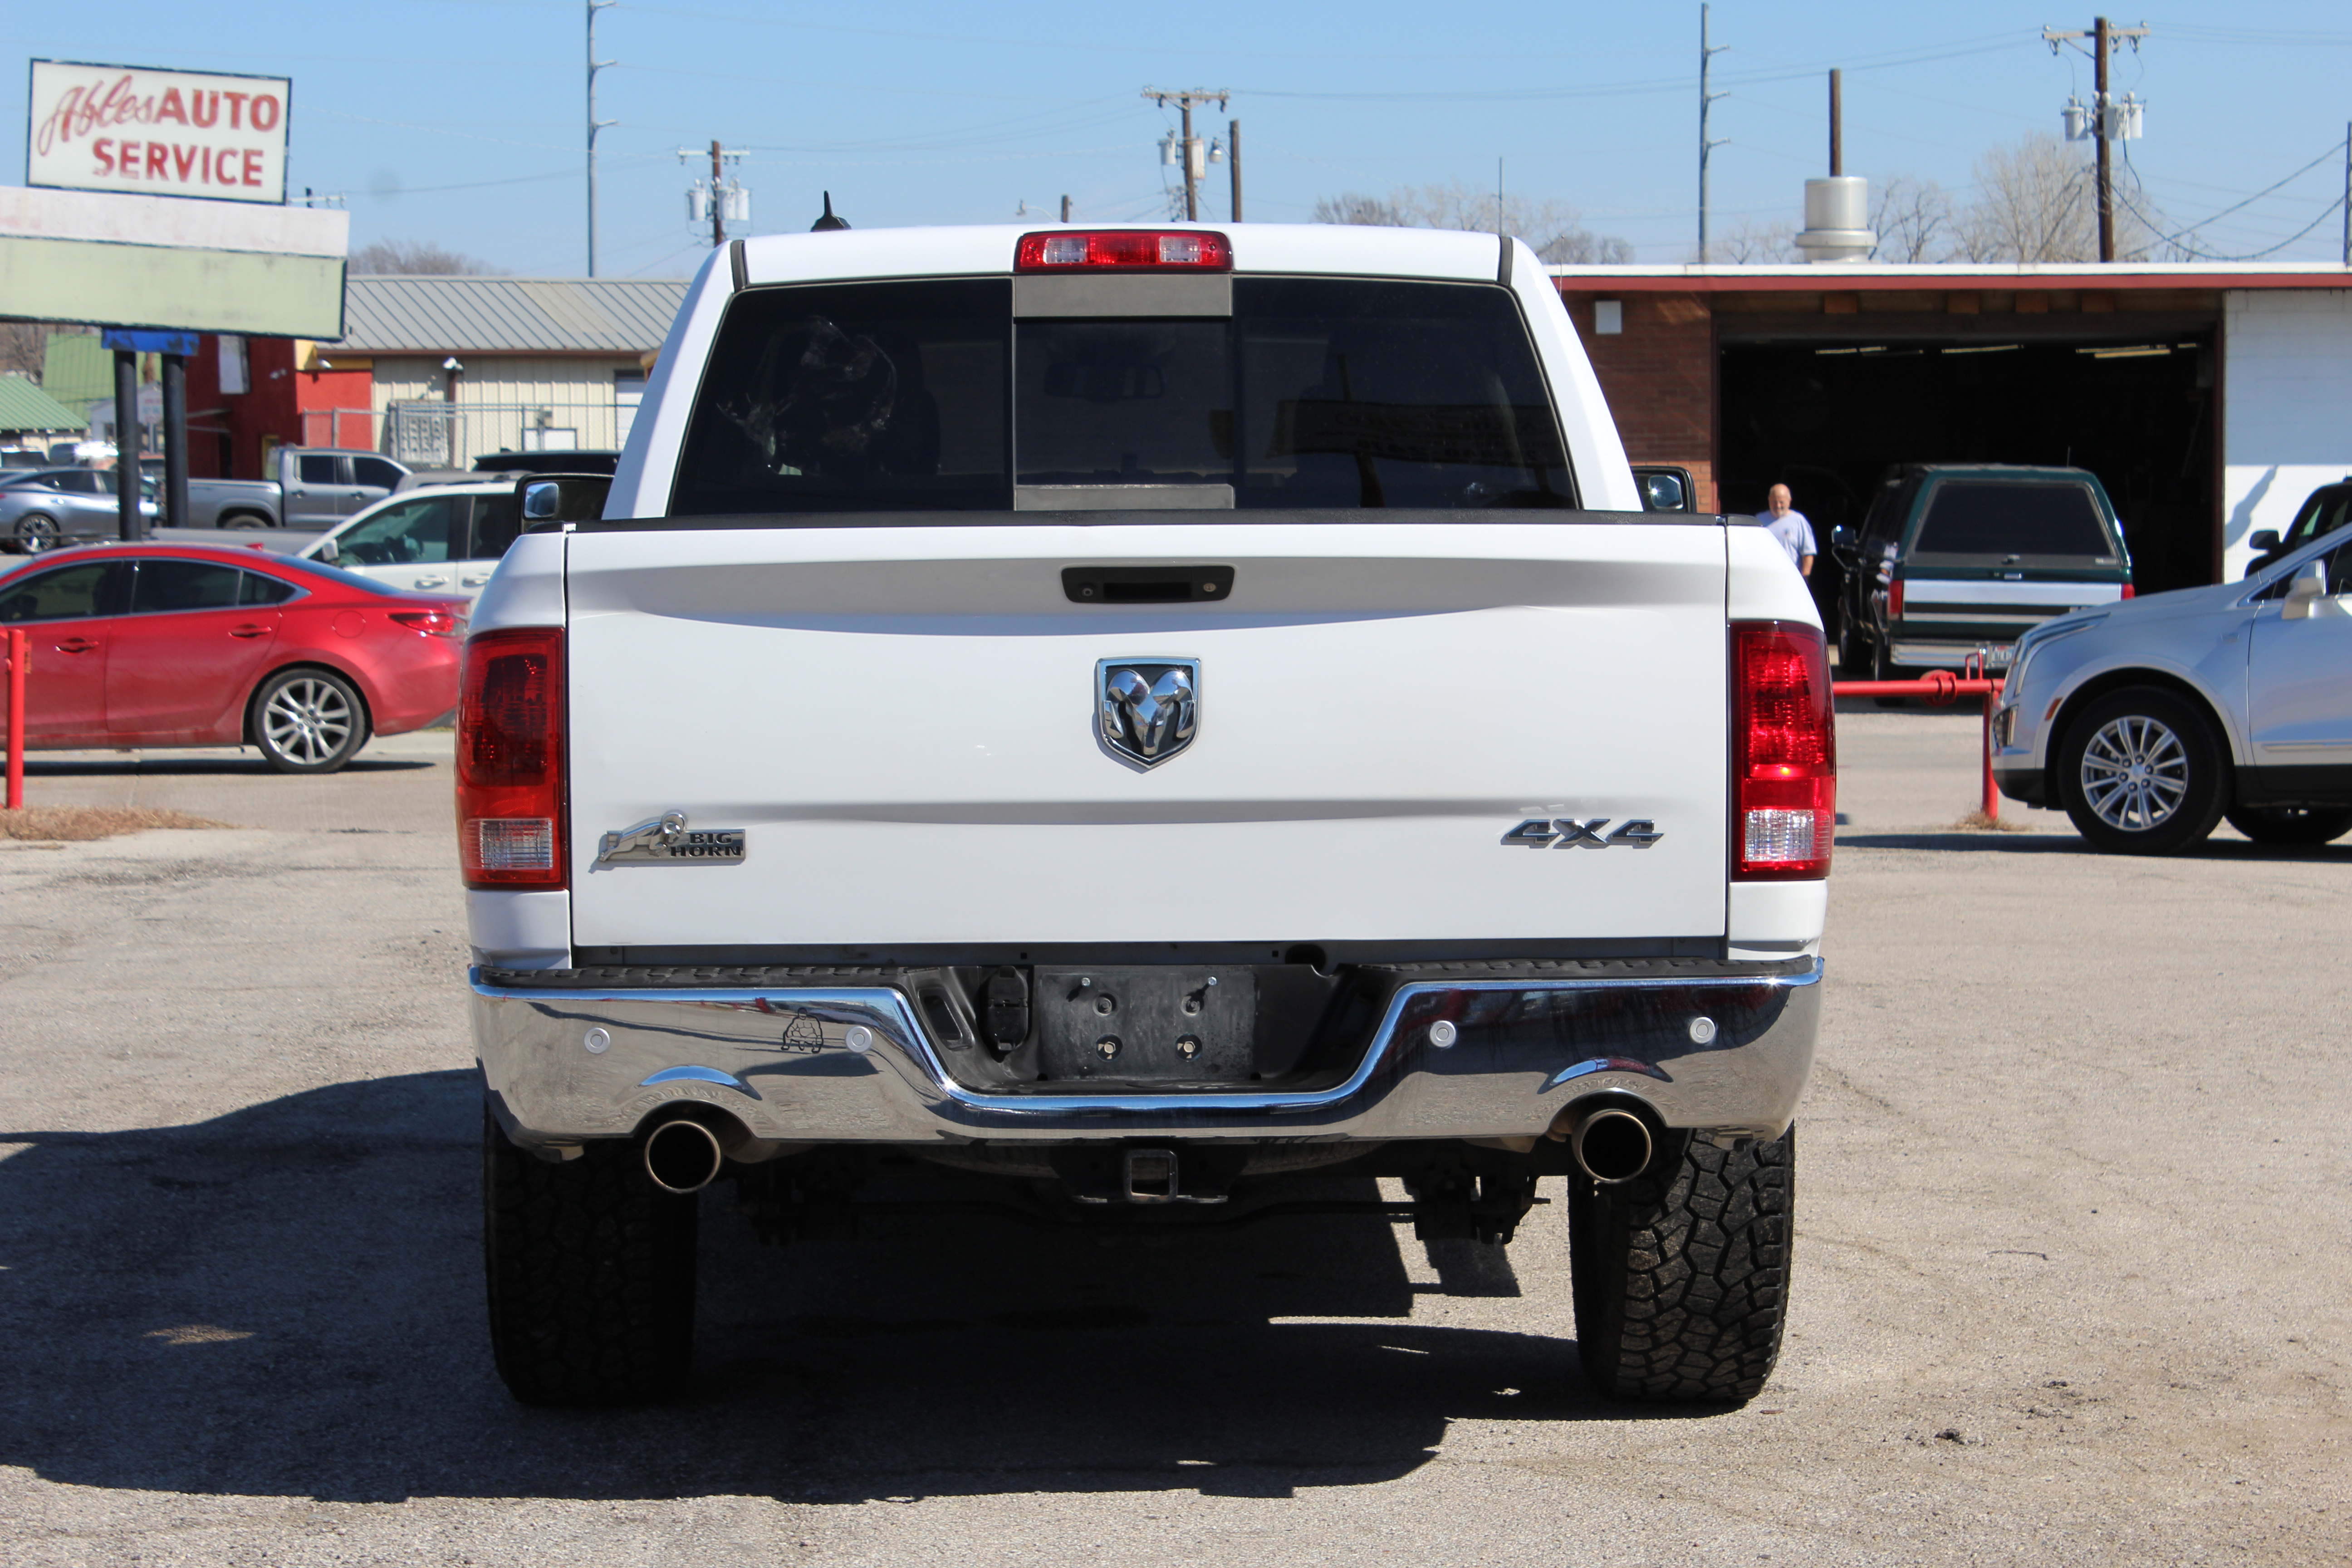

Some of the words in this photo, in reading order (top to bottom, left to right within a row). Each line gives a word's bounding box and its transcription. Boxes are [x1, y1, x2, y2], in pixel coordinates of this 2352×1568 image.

[152, 86, 280, 132] AUTO
[93, 137, 264, 187] SERVICE
[670, 846, 742, 857] HORN
[689, 832, 732, 844] BIG
